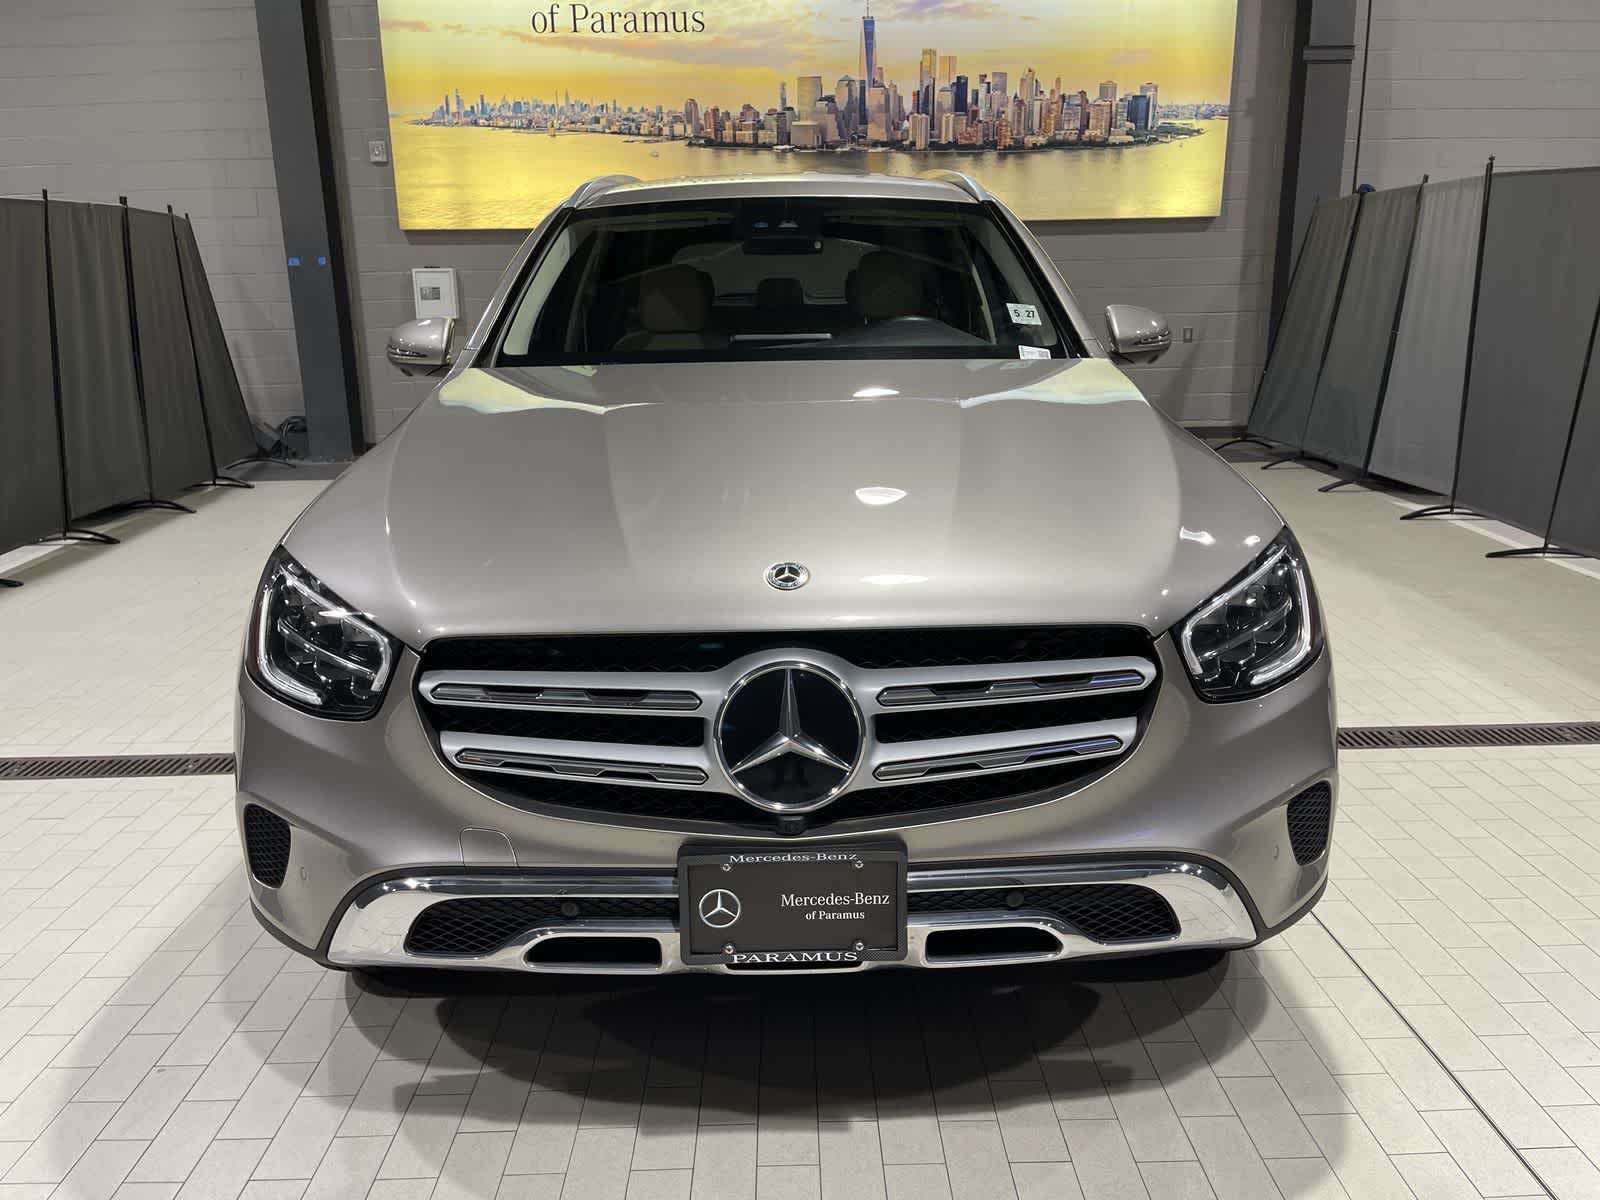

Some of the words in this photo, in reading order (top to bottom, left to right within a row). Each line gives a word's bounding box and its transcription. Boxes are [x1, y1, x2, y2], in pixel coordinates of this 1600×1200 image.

[531, 3, 560, 34] of
[568, 3, 705, 34] Paramus
[1013, 309, 1021, 318] 5
[1025, 310, 1035, 319] 27
[728, 852, 858, 864] Mercedes-Benz
[780, 891, 890, 907] Mercedes-Benz
[805, 910, 818, 921] of
[818, 910, 866, 921] Paramus
[732, 951, 859, 964] PARAMUS
